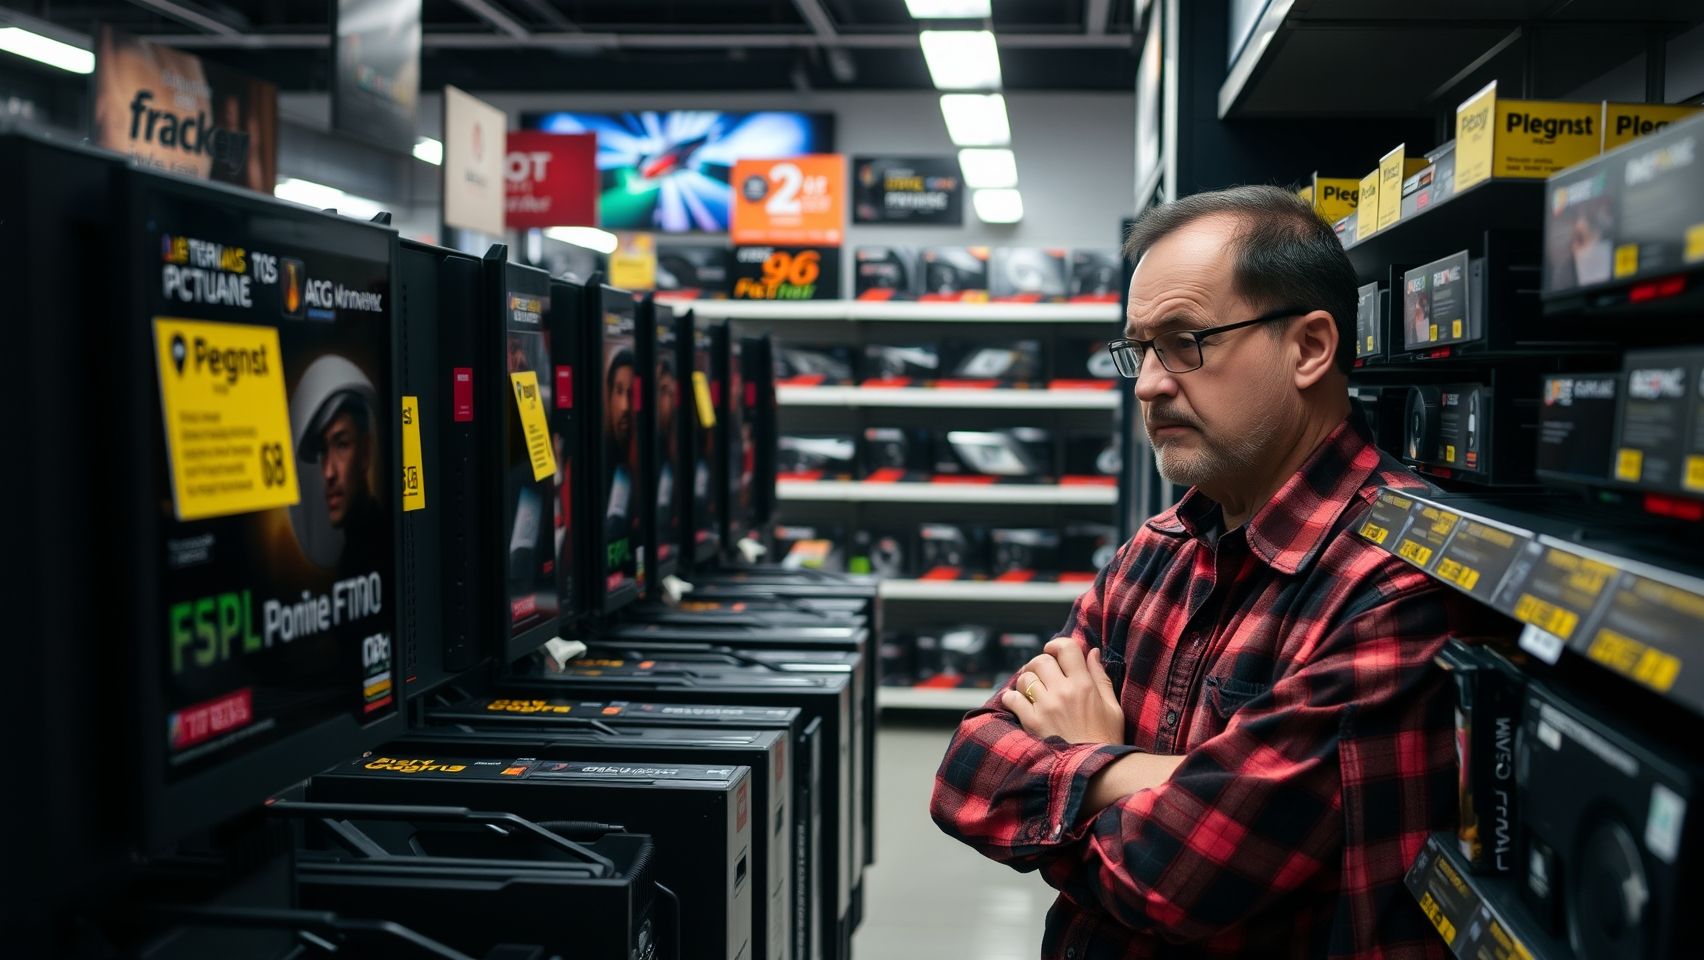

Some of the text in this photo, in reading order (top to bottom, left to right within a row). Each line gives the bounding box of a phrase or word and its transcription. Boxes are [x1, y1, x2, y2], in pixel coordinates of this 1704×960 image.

[1506, 112, 1593, 140] Plegnst
[765, 162, 804, 216] 2
[762, 250, 820, 286] 96
